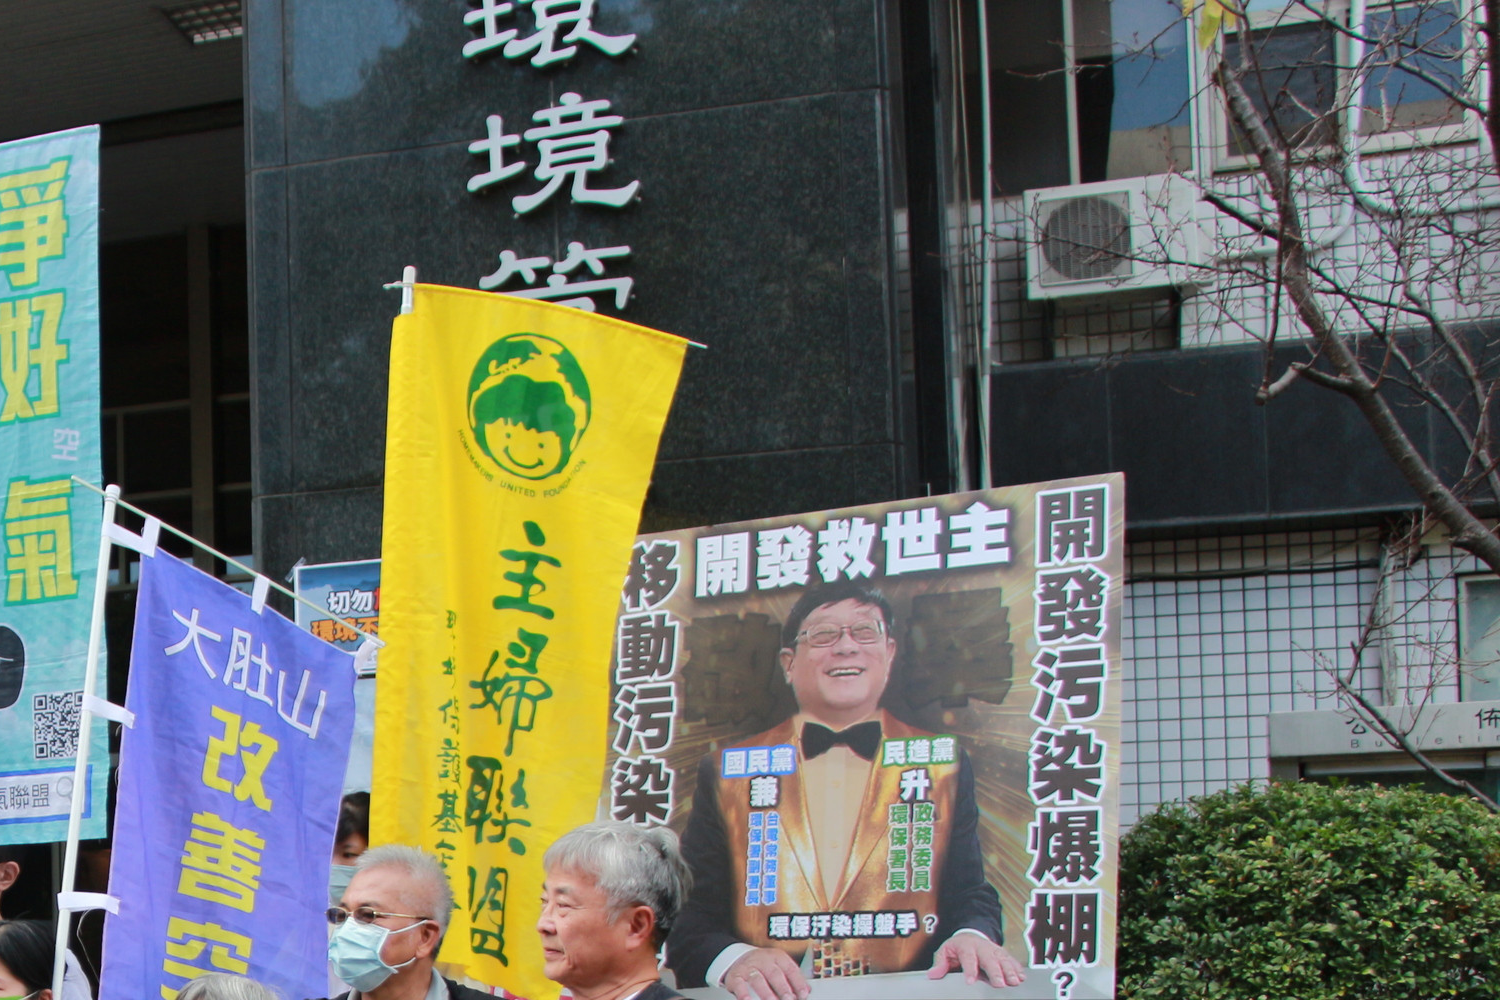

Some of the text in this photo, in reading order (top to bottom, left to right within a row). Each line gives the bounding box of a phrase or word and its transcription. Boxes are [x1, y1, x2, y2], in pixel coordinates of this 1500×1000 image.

[457, 429, 586, 498] HOMEMAKERS UNITED FOUNDATION
[695, 502, 1011, 599] 開發救世主
[327, 587, 380, 614] 切勿
[164, 608, 325, 739] 大肚山
[610, 538, 680, 825] 移動污染
[464, 520, 562, 968] 主婦聯盟
[724, 747, 794, 776] 國民黨
[882, 737, 955, 767] 民進黨
[900, 769, 930, 800] 升
[750, 776, 779, 807] 兼
[745, 812, 764, 906] 環保署副署長
[886, 803, 910, 893] 環保署長
[910, 803, 935, 892] 政務委員
